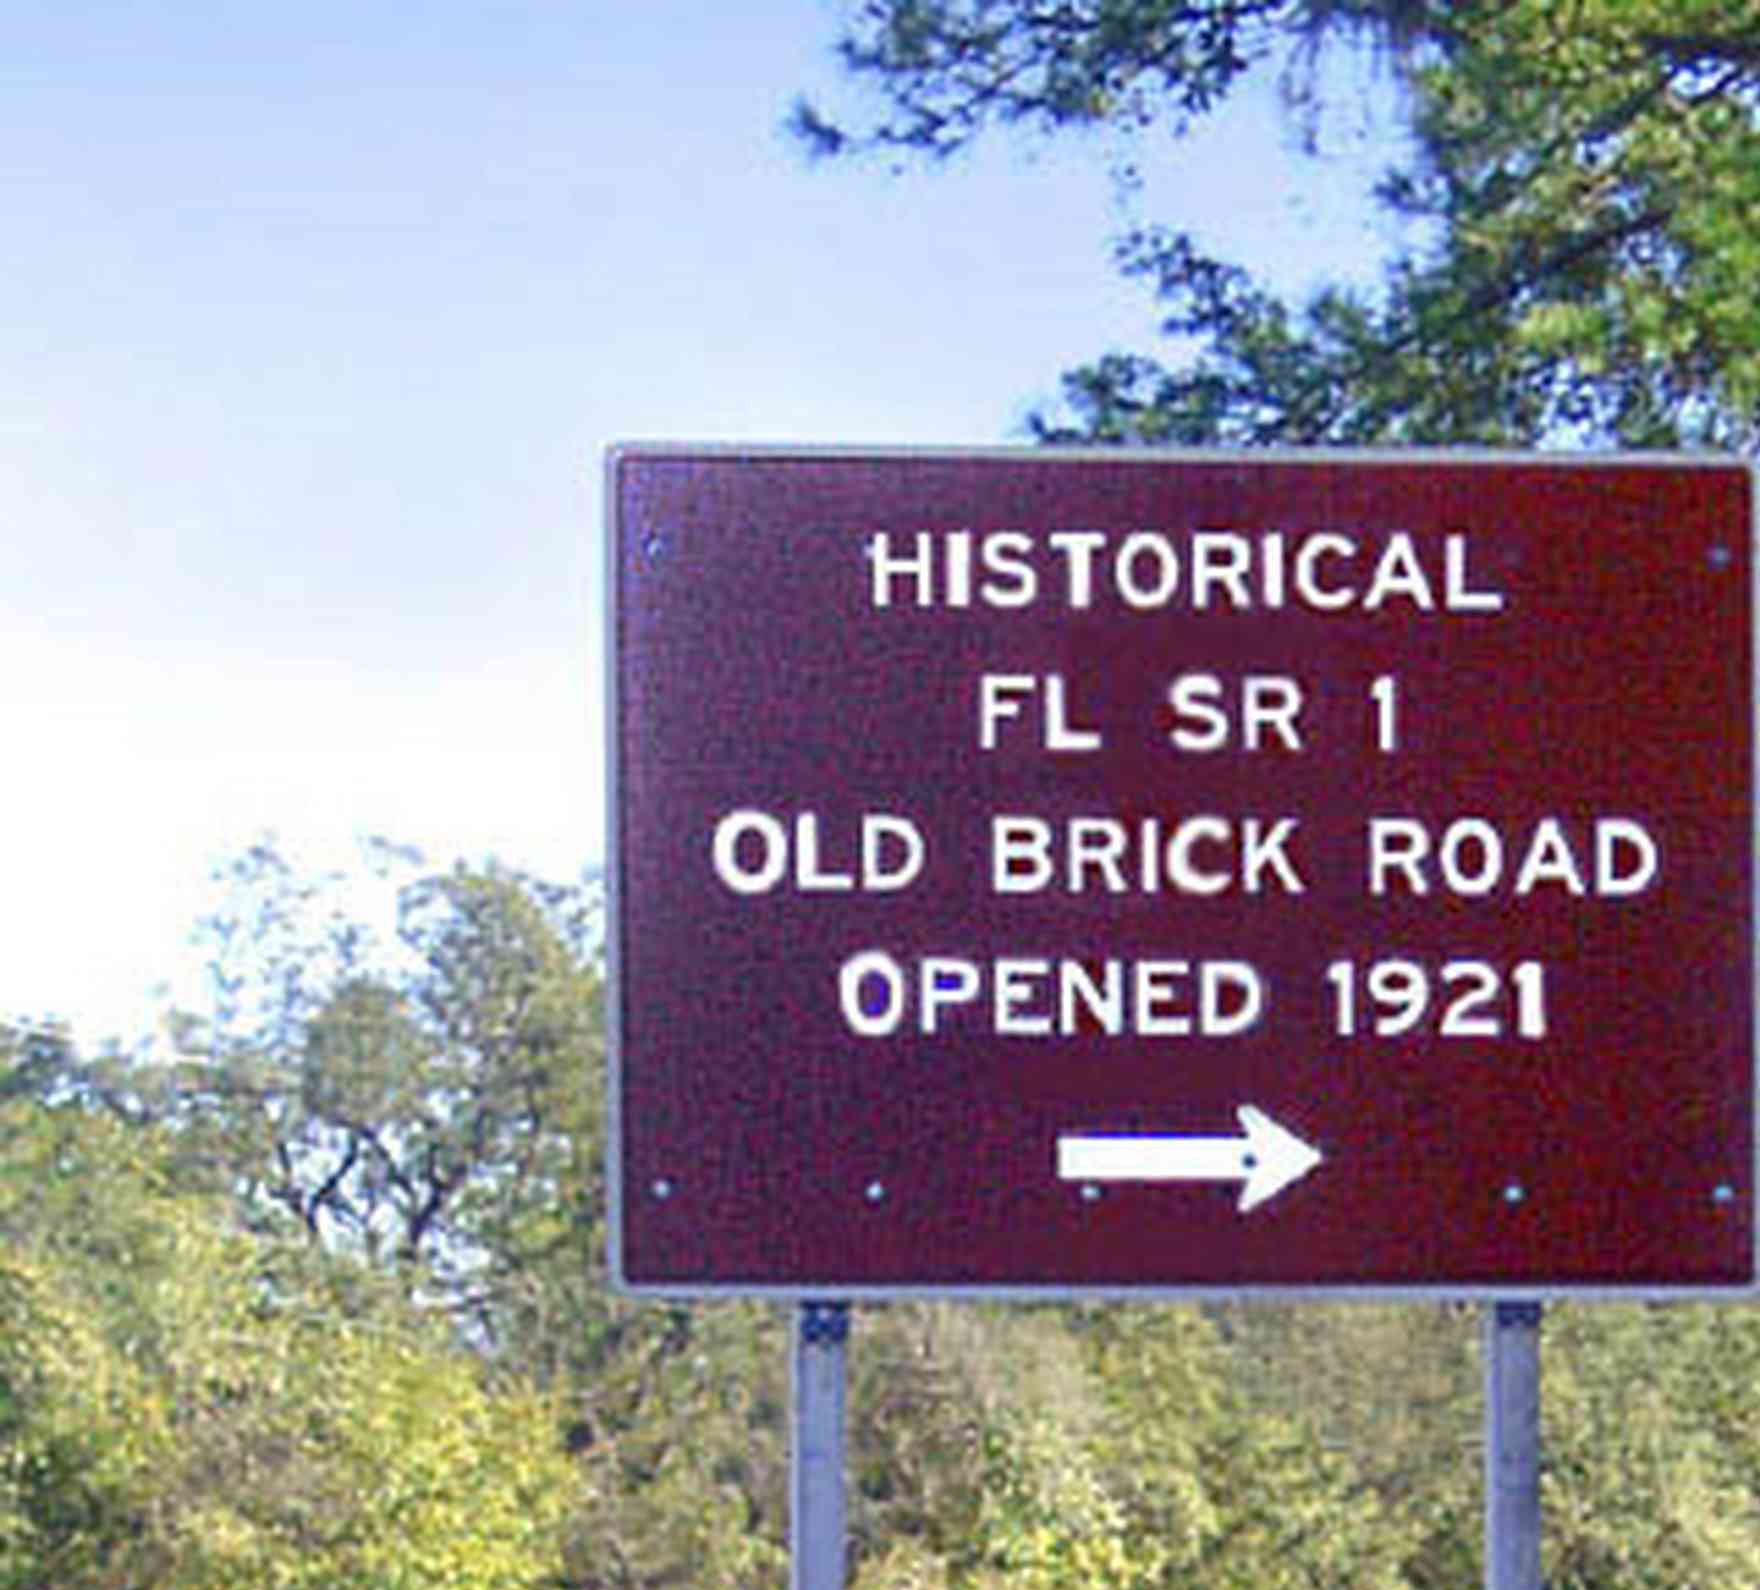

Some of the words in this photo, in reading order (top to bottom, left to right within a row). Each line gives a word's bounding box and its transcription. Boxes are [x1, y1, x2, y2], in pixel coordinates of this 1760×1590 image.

[868, 529, 1504, 610] HISTORICAL
[978, 673, 1103, 751] FL
[1168, 673, 1303, 752] SR
[1369, 674, 1397, 752] 1
[711, 808, 926, 895] OLD
[990, 814, 1304, 896] BRICK
[1368, 816, 1659, 897] ROAD
[837, 949, 1264, 1037] OPENED
[1326, 957, 1549, 1039] 1921
